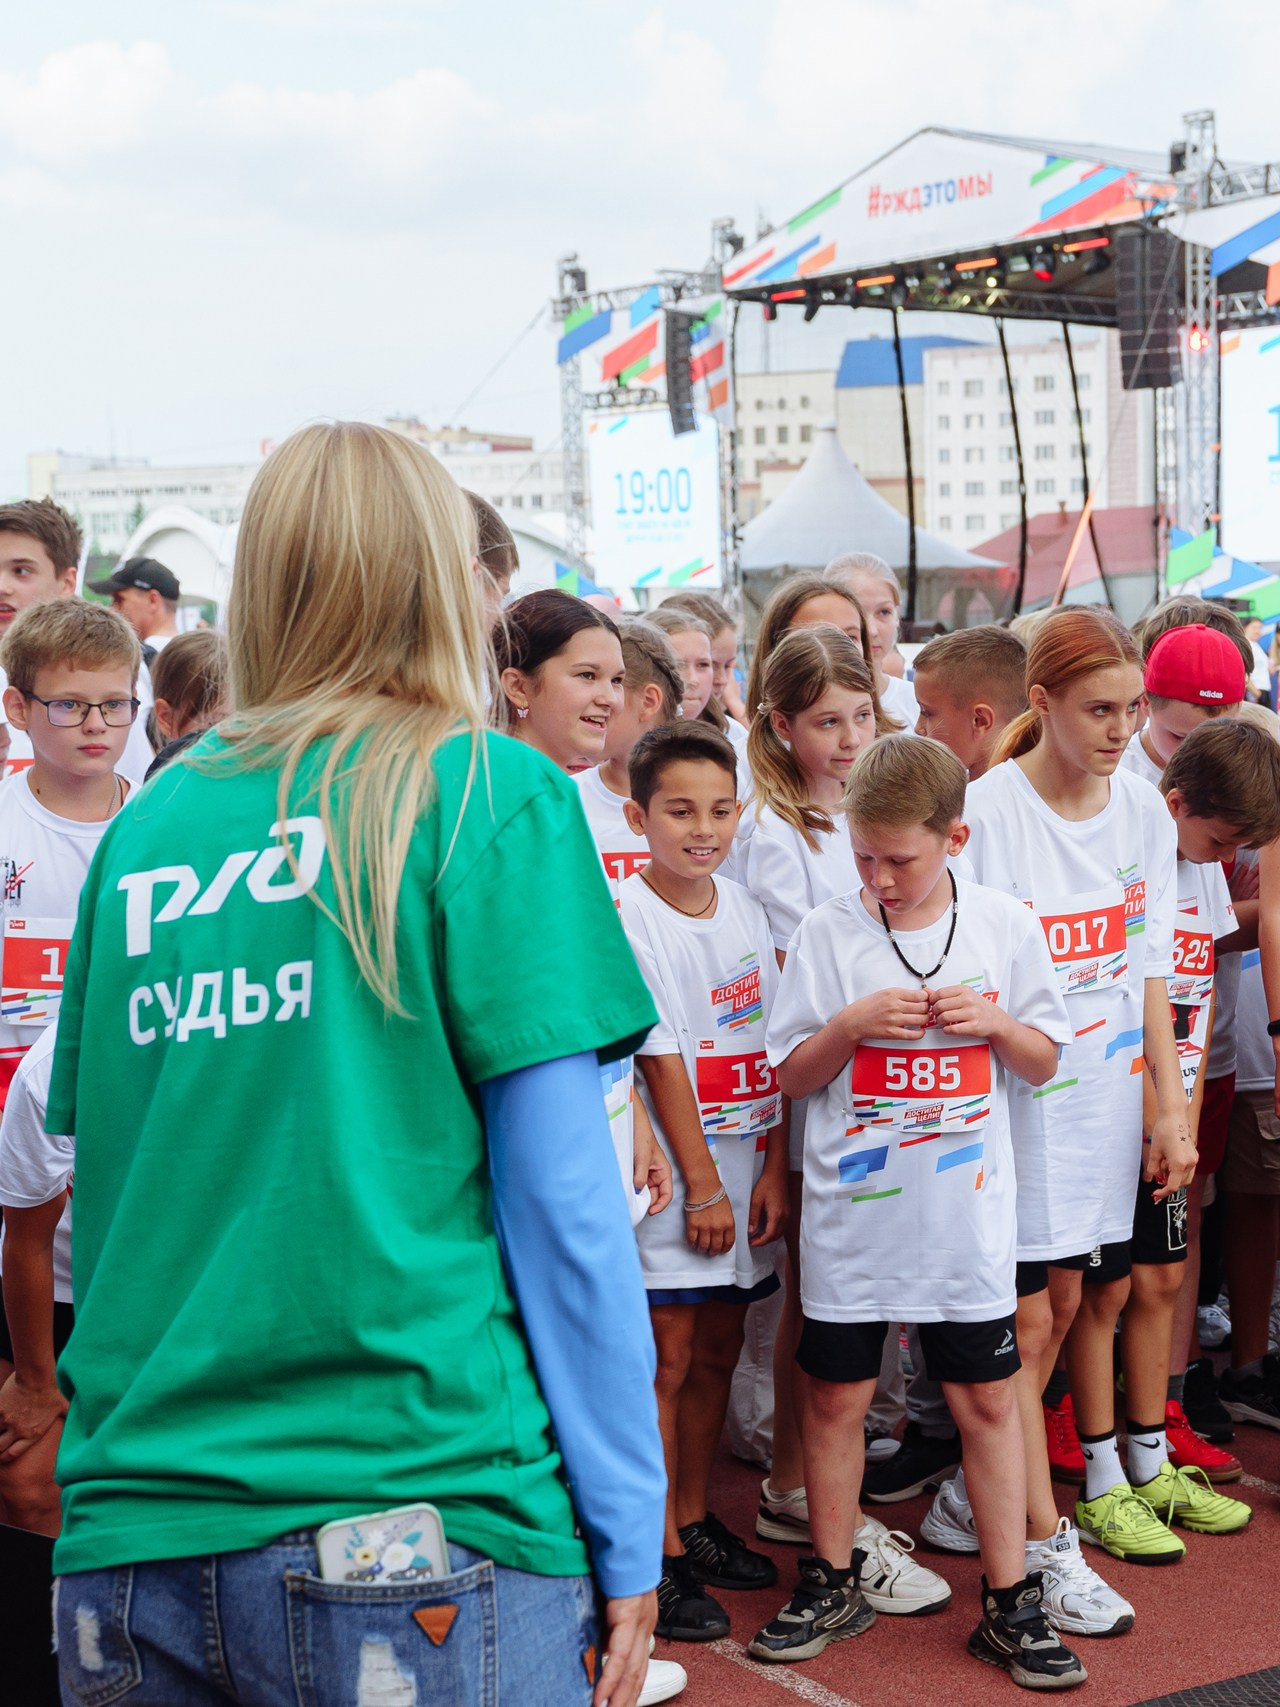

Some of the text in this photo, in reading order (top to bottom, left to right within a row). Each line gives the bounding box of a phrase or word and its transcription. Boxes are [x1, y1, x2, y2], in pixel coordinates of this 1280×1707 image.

[614, 466, 692, 514] 19:00
[1124, 884, 1146, 900] ГА
[1048, 915, 1108, 956] 017
[1171, 936, 1211, 970] 625
[128, 960, 313, 1046] СУДЬЯ
[885, 1056, 961, 1092] 585
[906, 1105, 942, 1119] ДОСТИГАЯ
